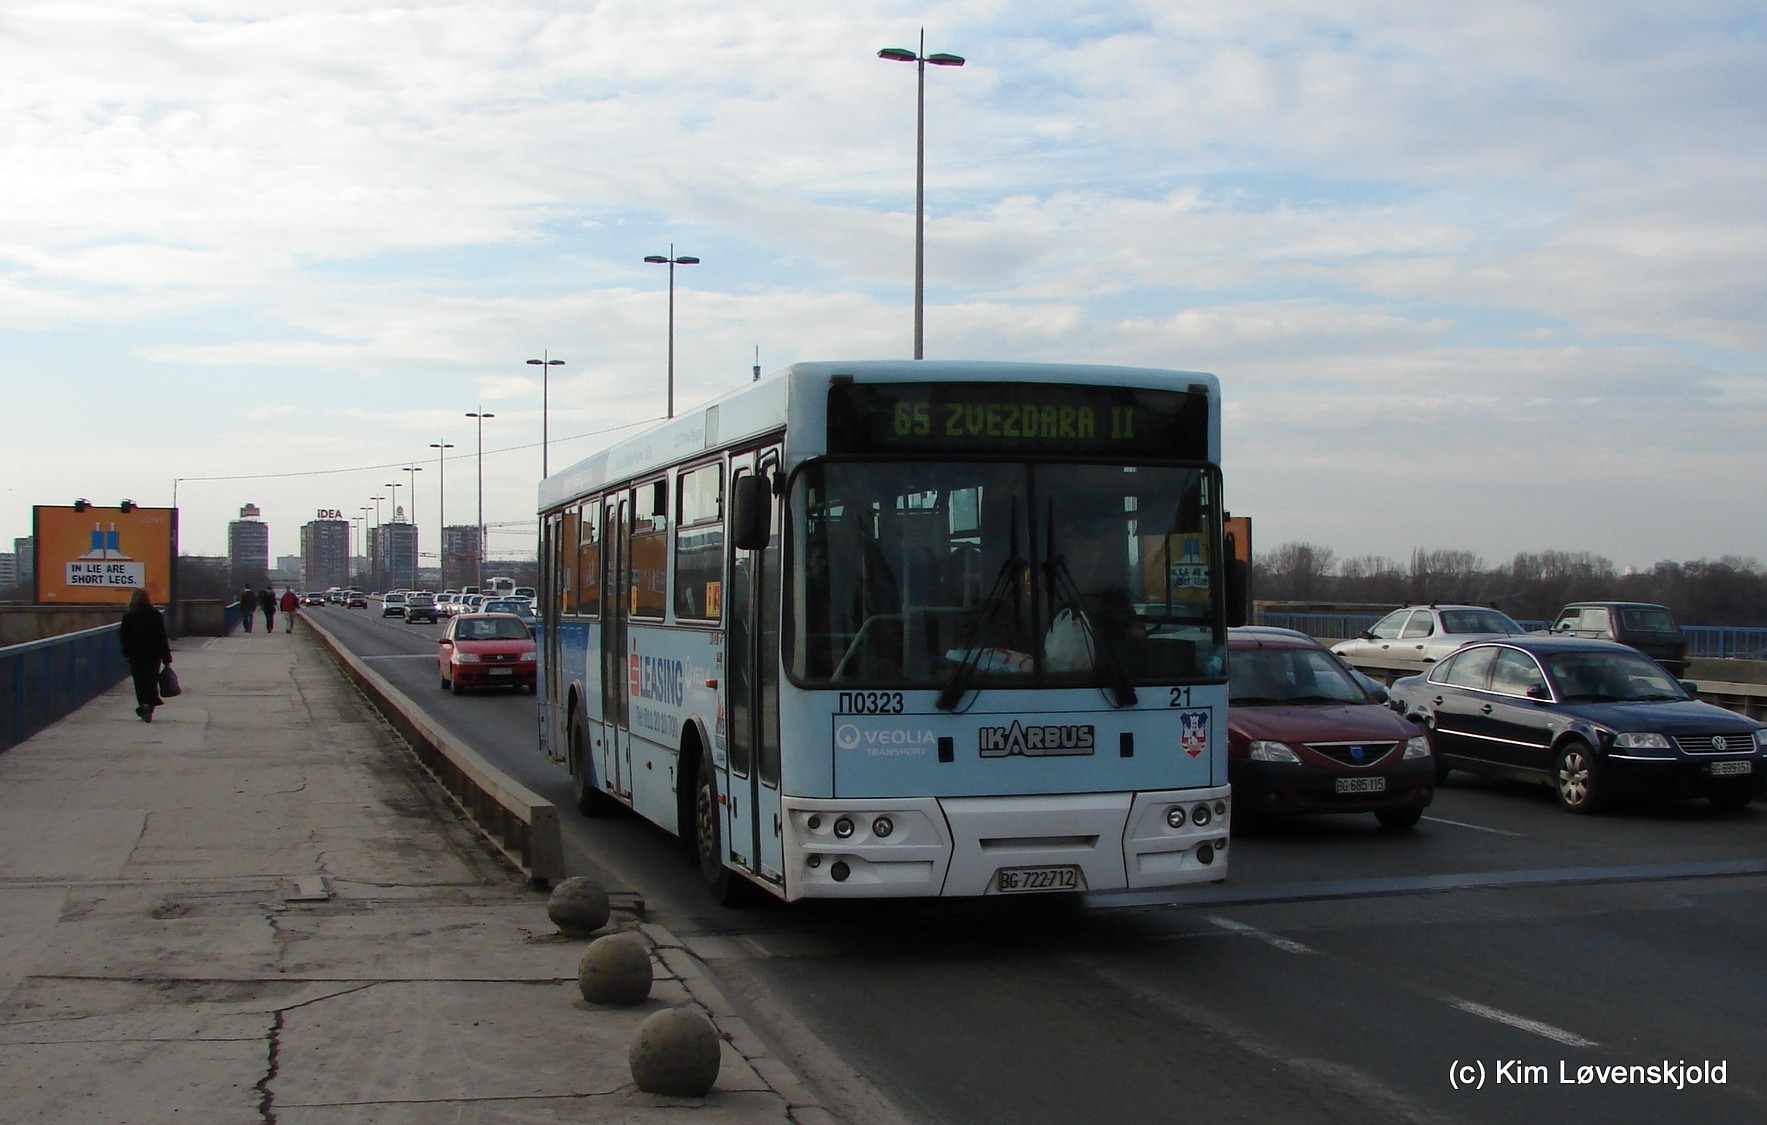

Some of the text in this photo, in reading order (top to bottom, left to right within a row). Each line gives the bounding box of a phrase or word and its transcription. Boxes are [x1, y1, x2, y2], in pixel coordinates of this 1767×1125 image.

[894, 402, 1135, 439] 65 ZVEZDARA II
[87, 565, 101, 573] LIE
[107, 565, 124, 573] ARE
[71, 575, 103, 583] SHORT
[640, 656, 683, 707] LEASING
[1169, 687, 1190, 707] 21
[864, 730, 936, 745] VEOLIA
[980, 720, 1094, 757] IKARBUS
[867, 748, 926, 756] TRANSPORT
